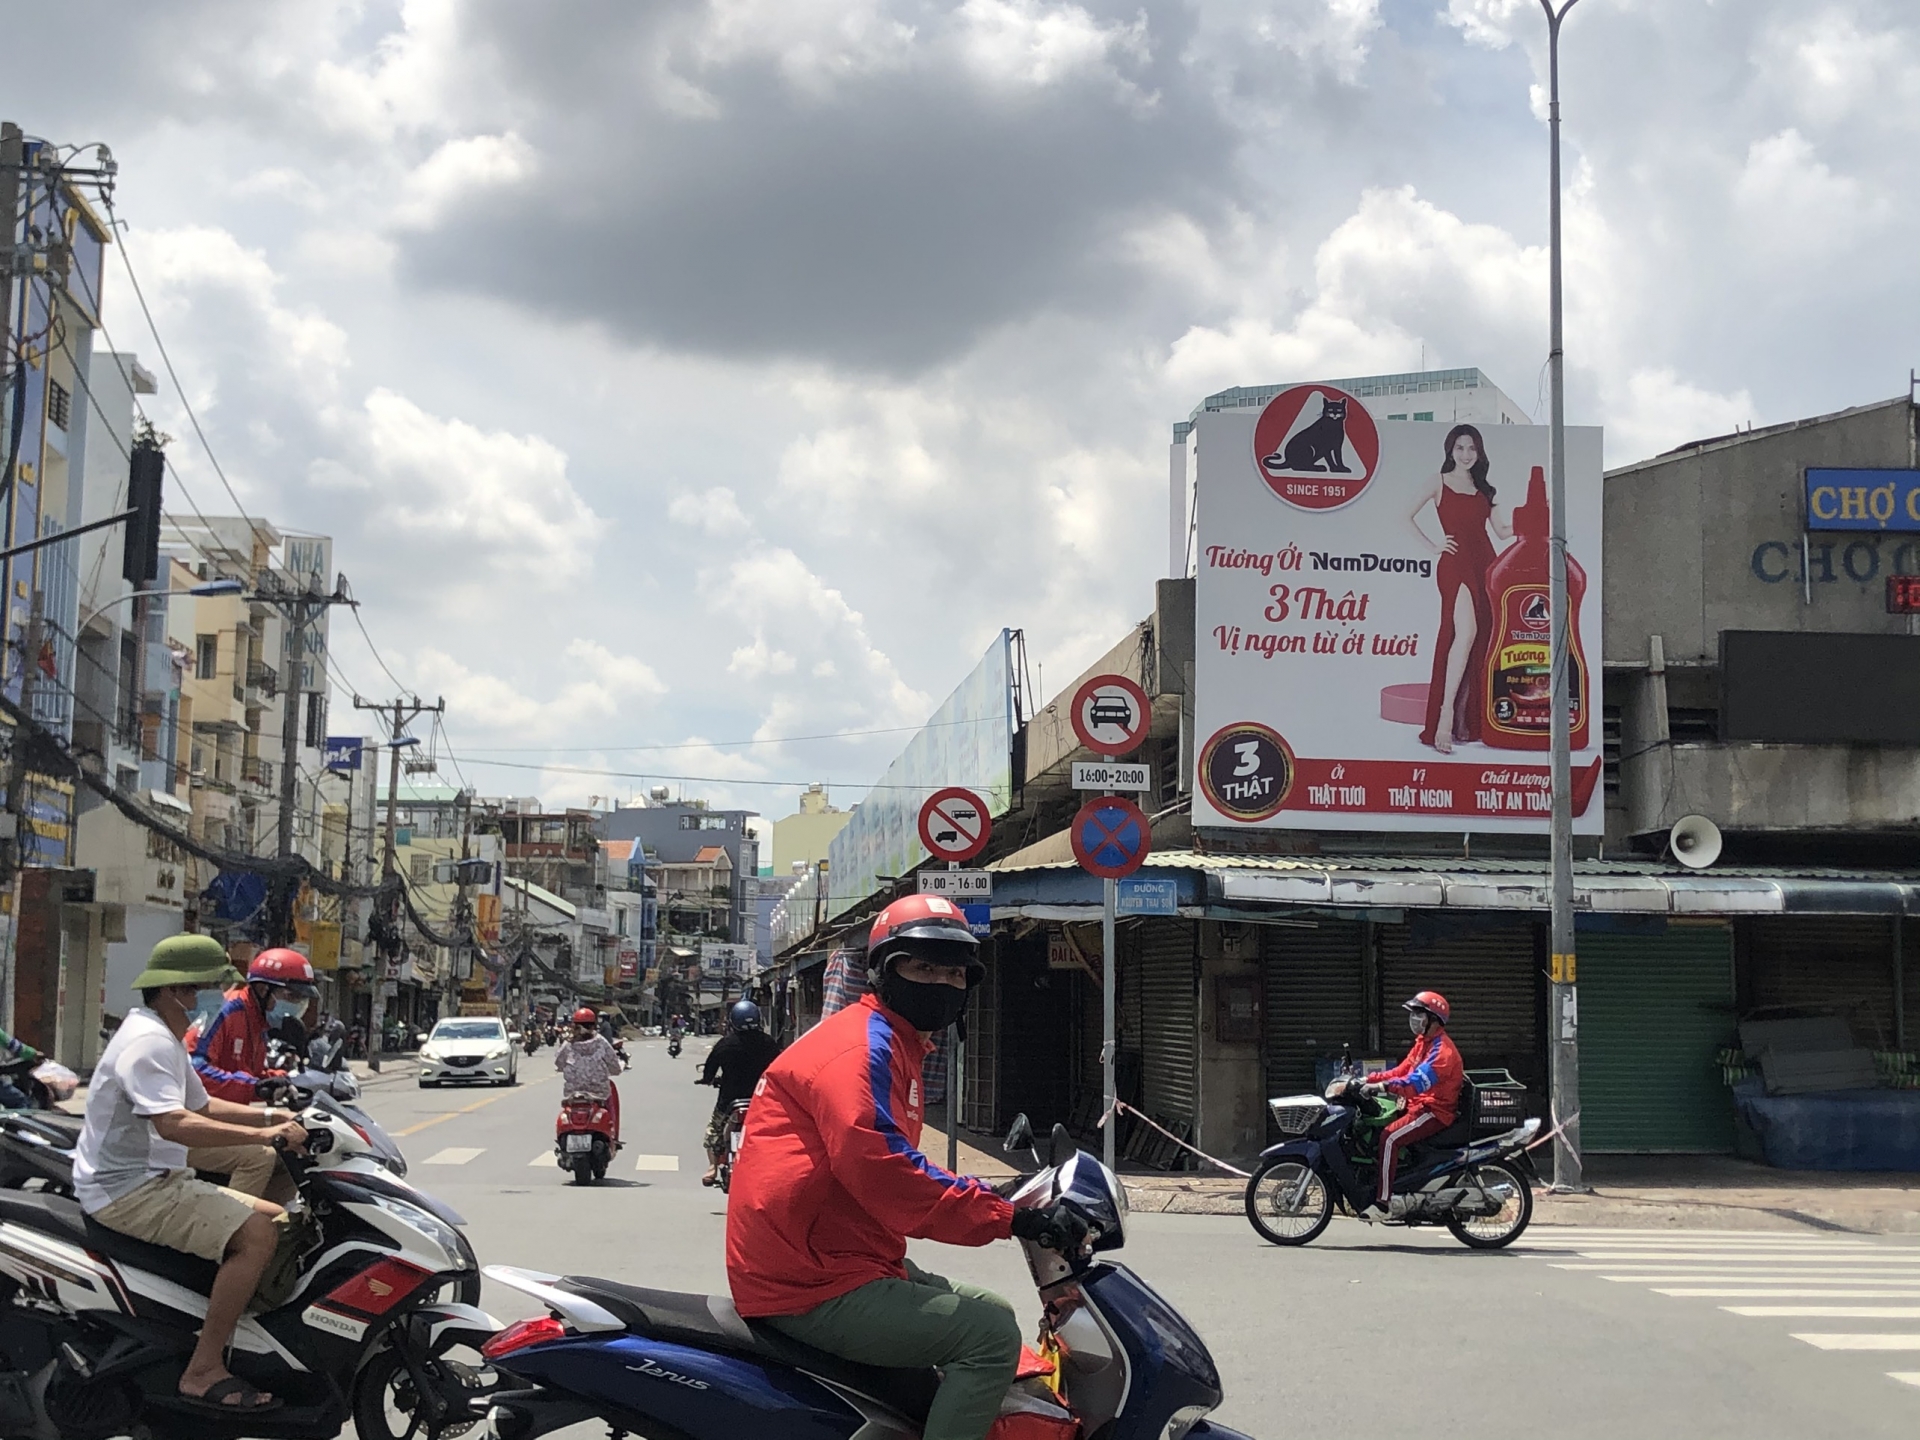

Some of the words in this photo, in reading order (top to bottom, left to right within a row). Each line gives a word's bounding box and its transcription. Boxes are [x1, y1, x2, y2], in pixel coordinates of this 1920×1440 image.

[1286, 484, 1319, 496] SINCE
[1322, 486, 1346, 497] 1951
[1811, 482, 1895, 528] CHỢ
[1206, 546, 1274, 577] Tương
[1277, 542, 1303, 571] Ớt
[1309, 552, 1431, 578] NamDương
[1264, 584, 1290, 622] 3
[1294, 590, 1370, 626] Thật
[1213, 625, 1241, 656] Vị
[1244, 634, 1306, 659] ngon
[1313, 630, 1339, 654] từ
[1342, 629, 1366, 655] ớt
[1372, 633, 1419, 656] tươi
[1504, 650, 1546, 664] Tương
[1500, 701, 1509, 712] 3
[1233, 740, 1261, 777] 3
[1331, 763, 1345, 780] Ớt
[1412, 768, 1427, 786] Vị
[1480, 770, 1510, 786] Chất
[1512, 772, 1550, 789] Lượng
[1222, 775, 1274, 801] THẬT
[1308, 783, 1336, 808] THẬT
[1339, 787, 1366, 806] TƯƠI
[1388, 785, 1417, 810] THẬT
[1419, 789, 1453, 808] NGON
[1475, 788, 1503, 813] THẬT
[1506, 791, 1521, 810] AN
[922, 877, 946, 889] 9:00
[957, 877, 988, 889] 16:00
[1134, 882, 1165, 893] ĐƯỜNG
[309, 1312, 358, 1334] HONDA
[625, 1358, 711, 1390] Janus
